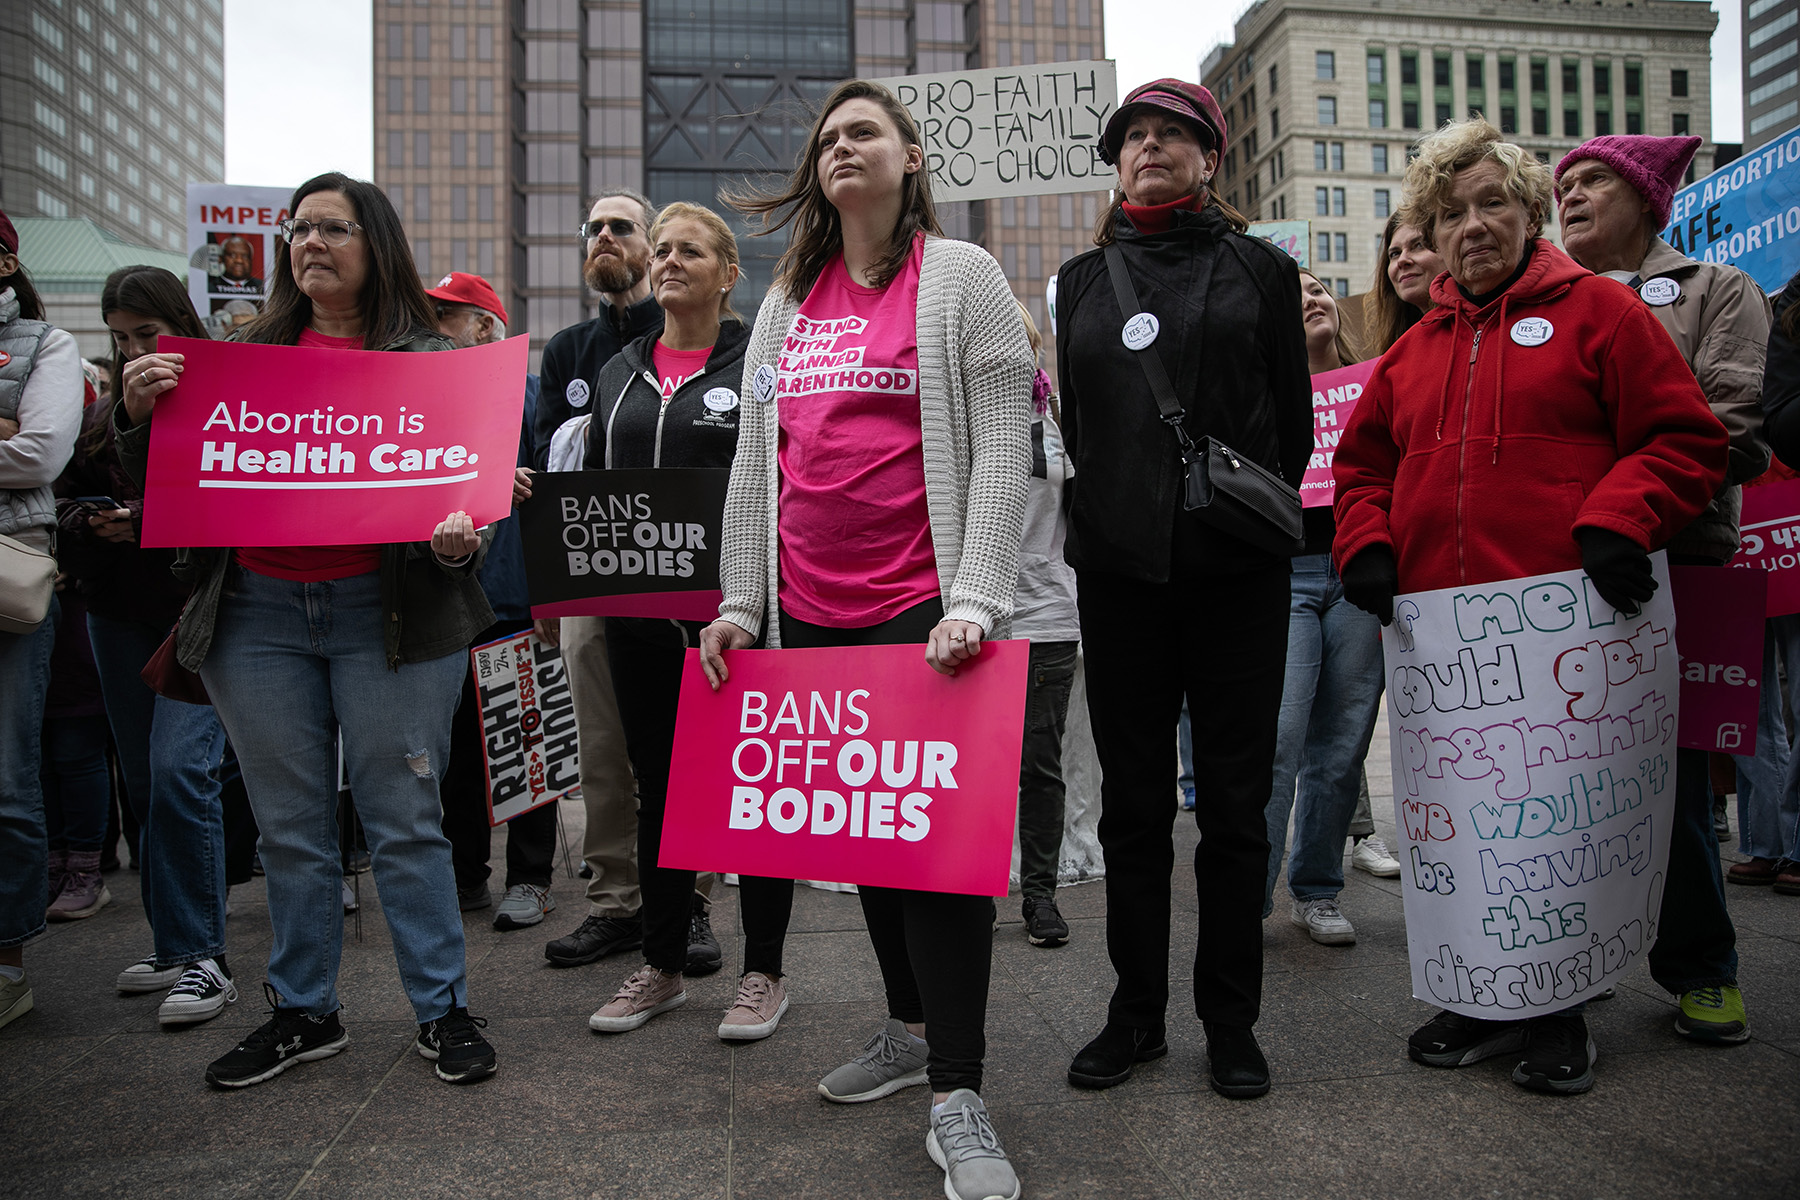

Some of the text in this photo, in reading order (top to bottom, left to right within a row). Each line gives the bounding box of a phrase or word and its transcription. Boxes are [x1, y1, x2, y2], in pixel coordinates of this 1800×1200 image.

[897, 70, 1096, 114] PRO-FAITH
[926, 145, 1115, 188] RO-CHOICE
[1668, 135, 1800, 227] EP ABORTIO
[200, 205, 291, 227] IMPEA
[1658, 202, 1733, 255] AFE.
[1703, 206, 1800, 264] ABORTIO
[1649, 286, 1662, 294] YES
[794, 317, 863, 336] STAND
[1128, 326, 1141, 338] YES
[1520, 325, 1534, 333] YES
[777, 371, 911, 395] ARENTHOOD
[1312, 382, 1364, 408] AND
[202, 400, 425, 435] Abortion is
[200, 440, 479, 474] Health Care.
[1300, 479, 1329, 490] anned
[560, 493, 652, 523] BANS
[562, 521, 708, 550] OFF OUR
[567, 549, 695, 578] BODIES
[1391, 621, 1669, 722] could get
[1679, 655, 1758, 688] are.
[520, 707, 545, 754] TO
[739, 689, 871, 737] BANS
[479, 681, 528, 807] RIGHT
[731, 737, 959, 789] OFF OUR
[1399, 690, 1675, 800] pregnant,
[528, 761, 546, 803] YES
[728, 785, 934, 842] BODIES
[1401, 798, 1456, 842] we
[1410, 814, 1652, 896] be having
[1425, 871, 1663, 1009] discussion!
[1482, 895, 1588, 951] this
